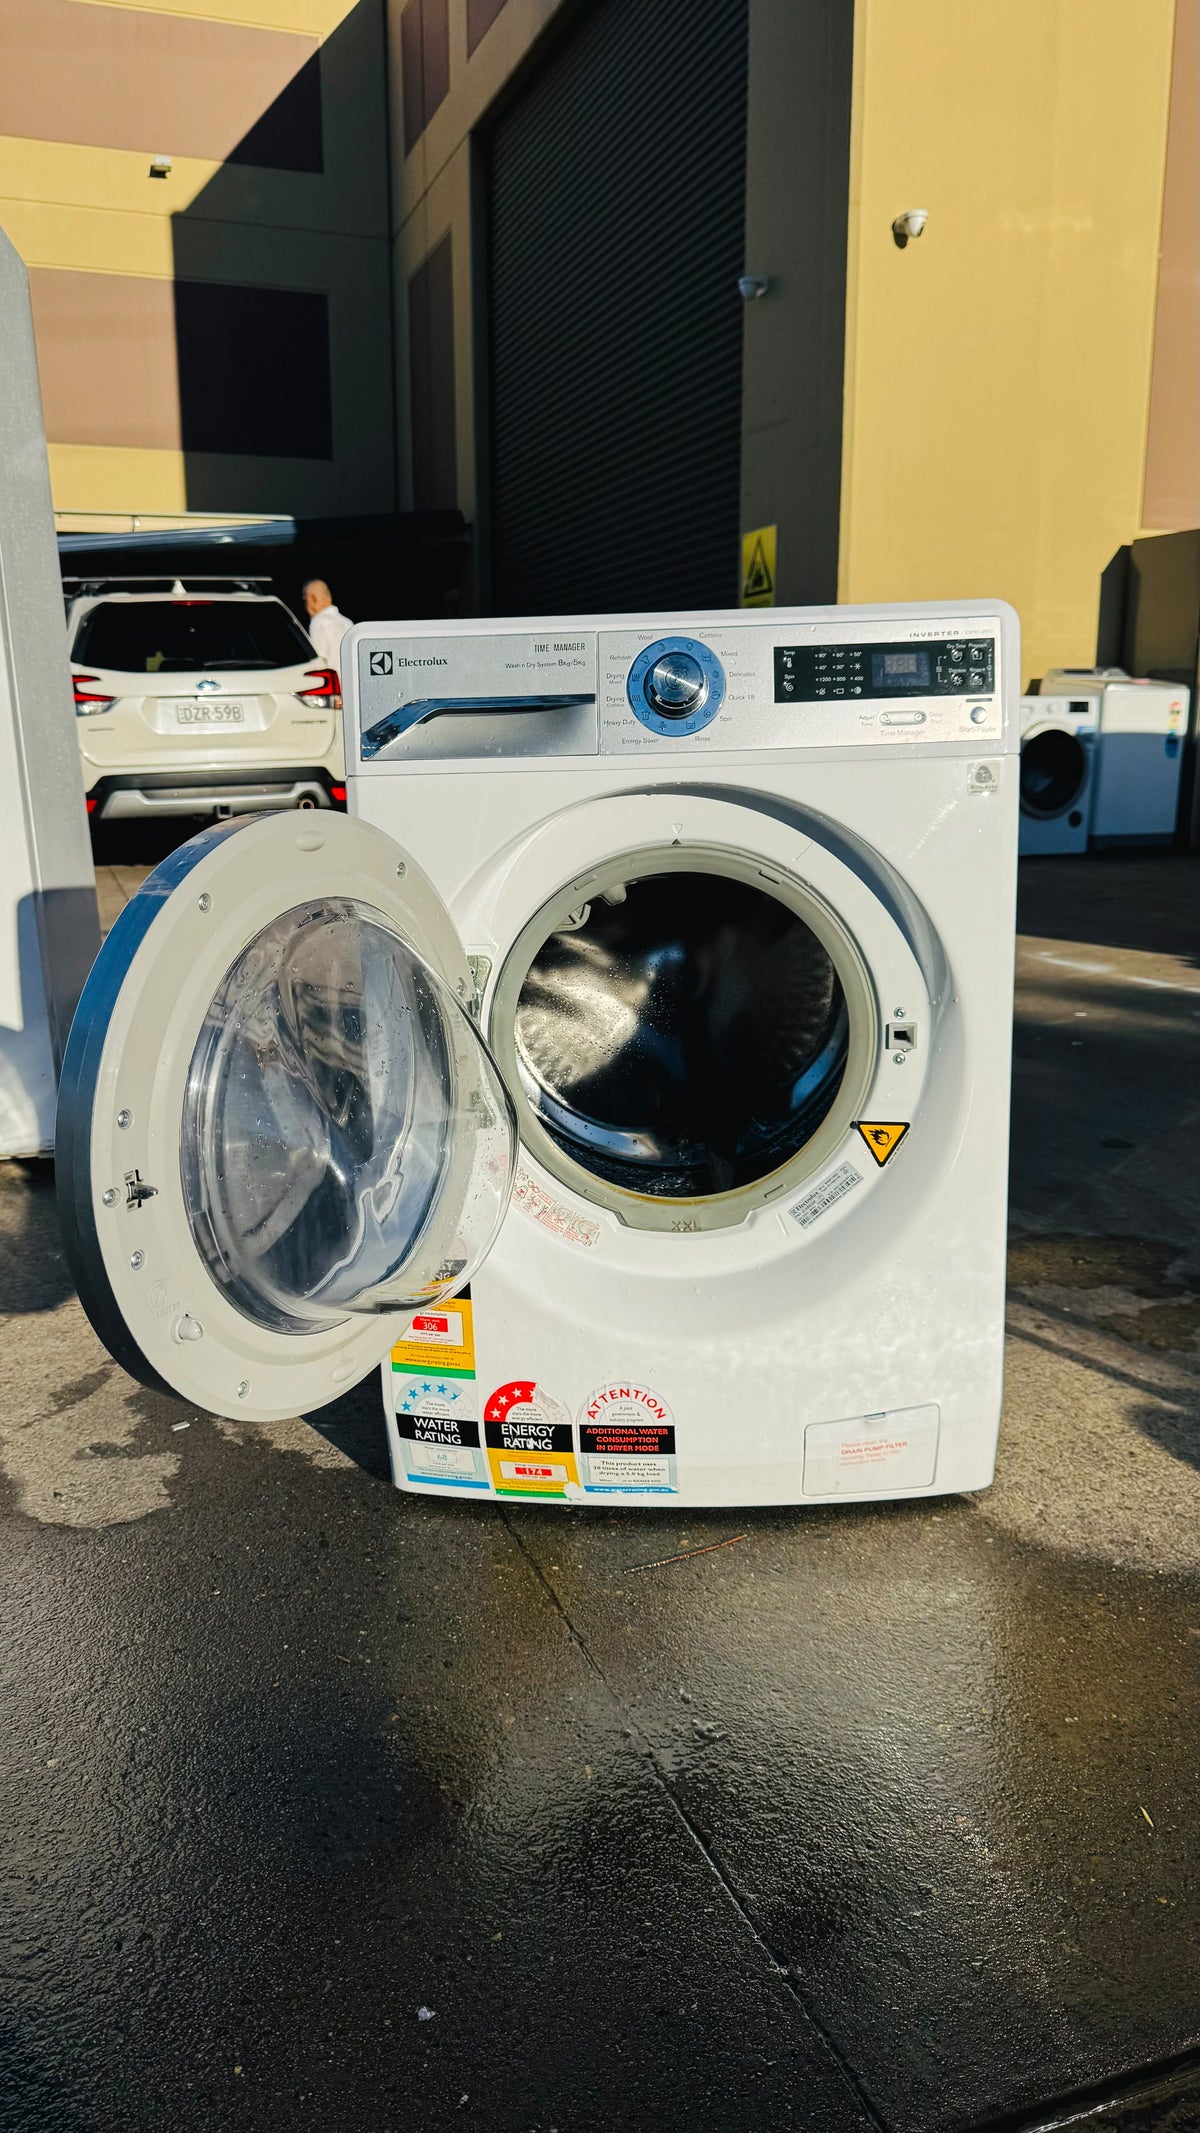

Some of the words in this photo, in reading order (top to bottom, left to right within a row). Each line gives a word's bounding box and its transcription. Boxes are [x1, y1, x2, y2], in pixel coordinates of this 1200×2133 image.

[909, 630, 959, 638] INVERTER
[534, 644, 549, 653] TIME
[554, 642, 586, 651] MANAGER
[398, 657, 448, 667] Electrolux
[671, 1220, 702, 1232] XXL
[422, 1322, 438, 1331] 306
[587, 1388, 667, 1420] ATTENTION
[414, 1417, 460, 1433] WATER
[501, 1424, 556, 1437] ENERGY
[415, 1430, 462, 1445] RATING
